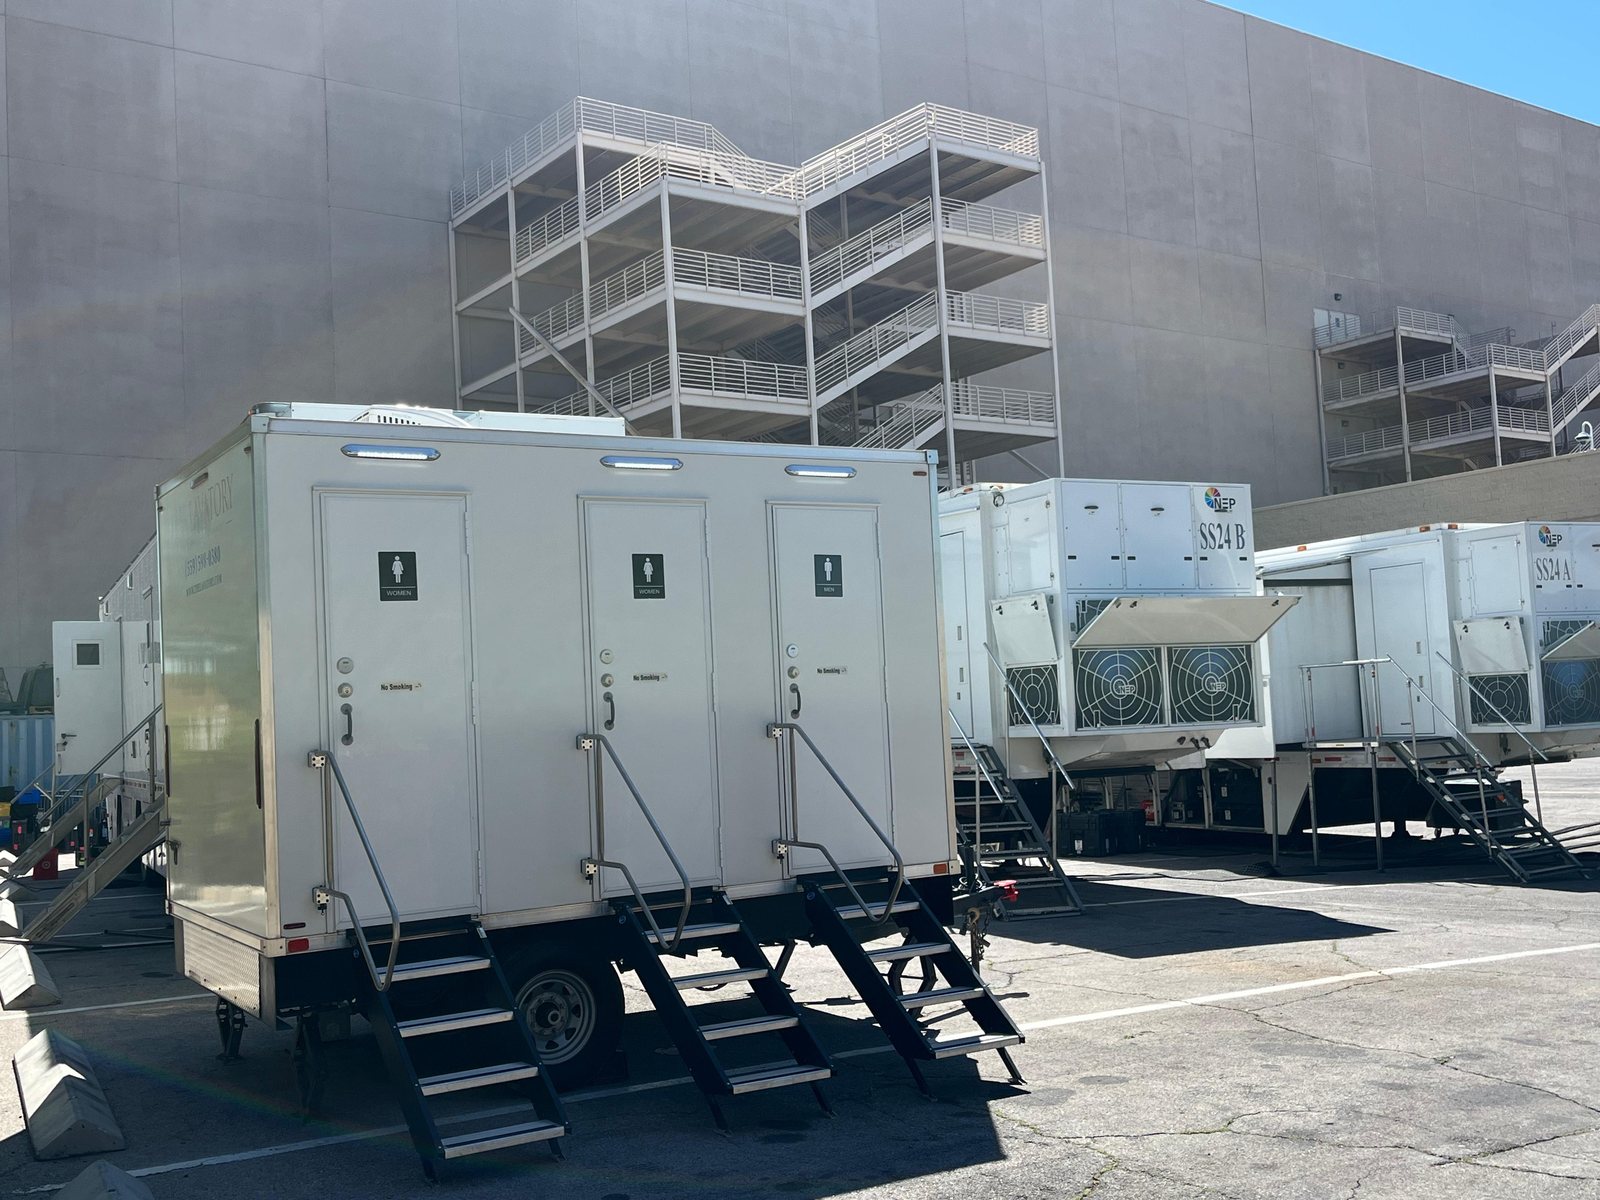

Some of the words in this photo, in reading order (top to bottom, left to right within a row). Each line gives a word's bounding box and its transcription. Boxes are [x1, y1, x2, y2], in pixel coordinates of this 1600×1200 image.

[1214, 498, 1236, 510] NEP
[1200, 523, 1232, 550] SS24
[1234, 523, 1246, 550] B
[1545, 534, 1563, 545] NEP
[1535, 557, 1560, 581] SS24
[1562, 558, 1571, 581] A
[386, 589, 412, 597] WOMEN
[816, 667, 823, 675] No
[823, 667, 841, 675] Smoking
[633, 674, 640, 682] No
[640, 673, 660, 682] Smoking
[380, 683, 389, 691] No
[389, 683, 413, 692] Smoking
[1120, 684, 1136, 695] NEP
[1211, 681, 1227, 692] NEP
